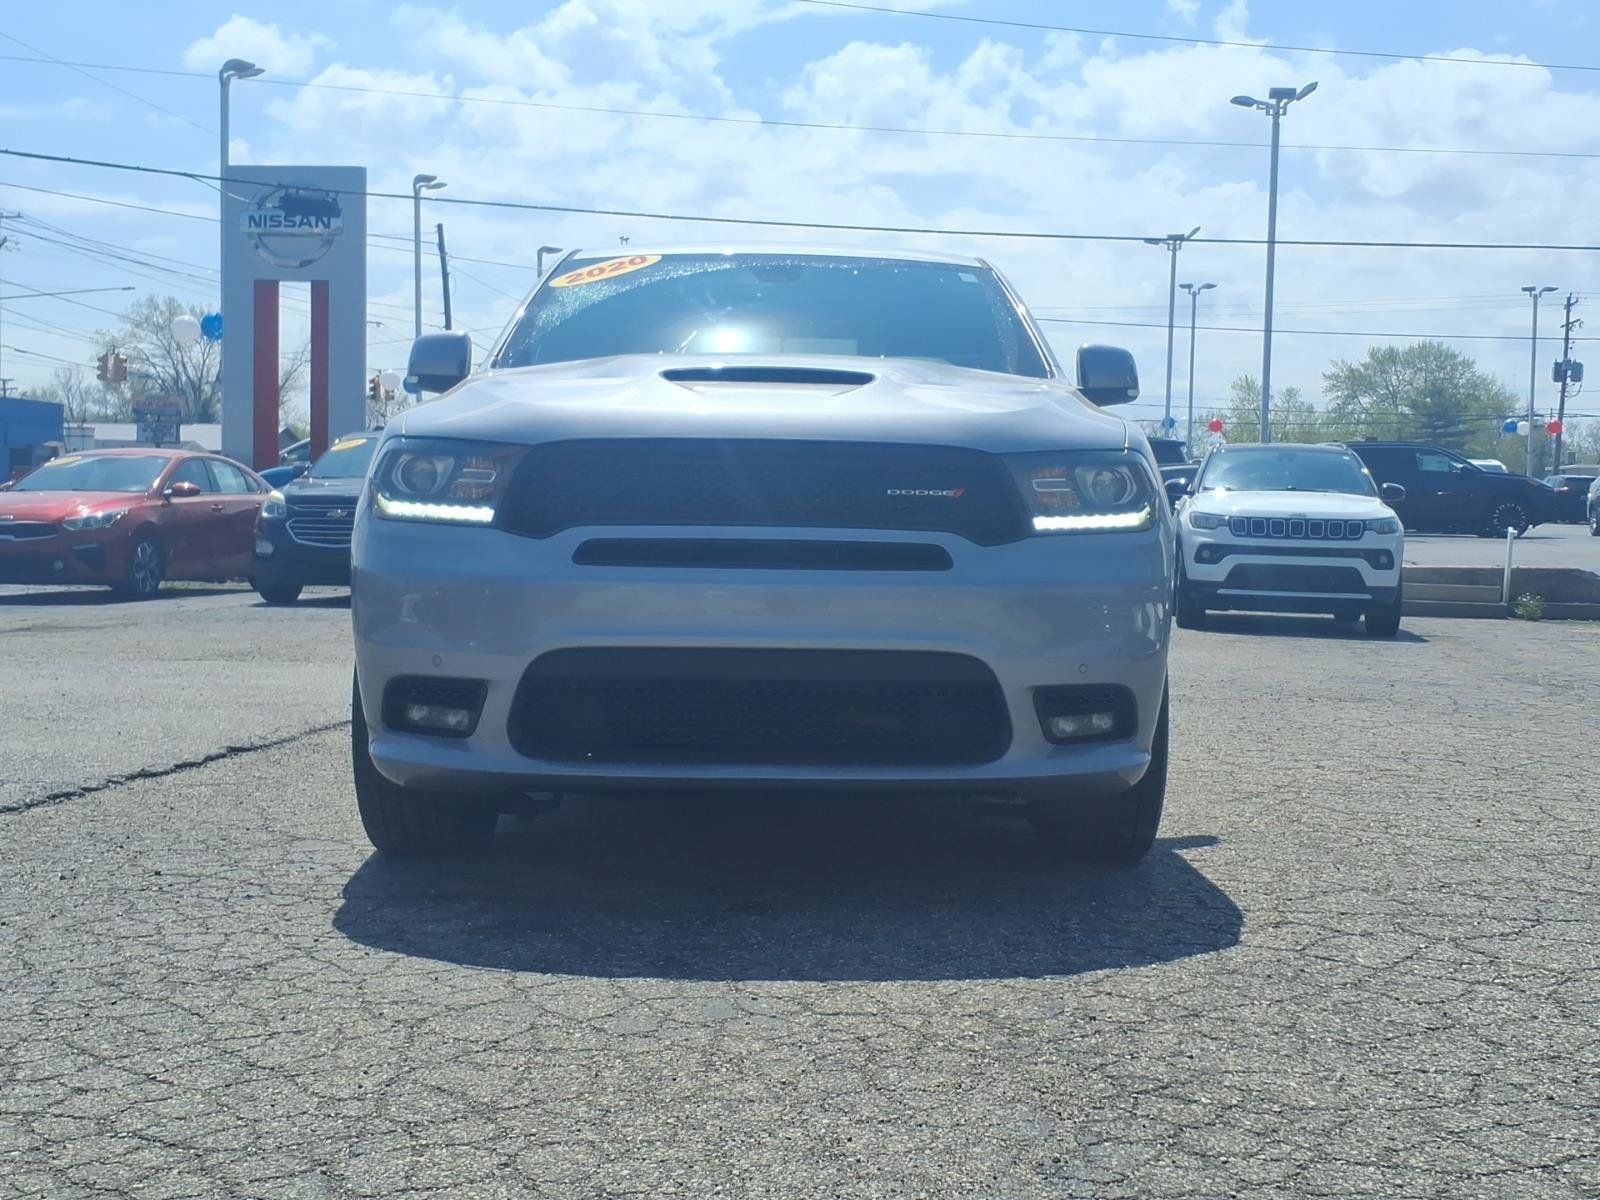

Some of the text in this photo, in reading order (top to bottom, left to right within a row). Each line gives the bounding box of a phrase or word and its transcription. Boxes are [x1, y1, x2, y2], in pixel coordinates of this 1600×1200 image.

[248, 214, 331, 229] NISSAN
[564, 256, 648, 285] 2020
[887, 489, 955, 497] DODGE
